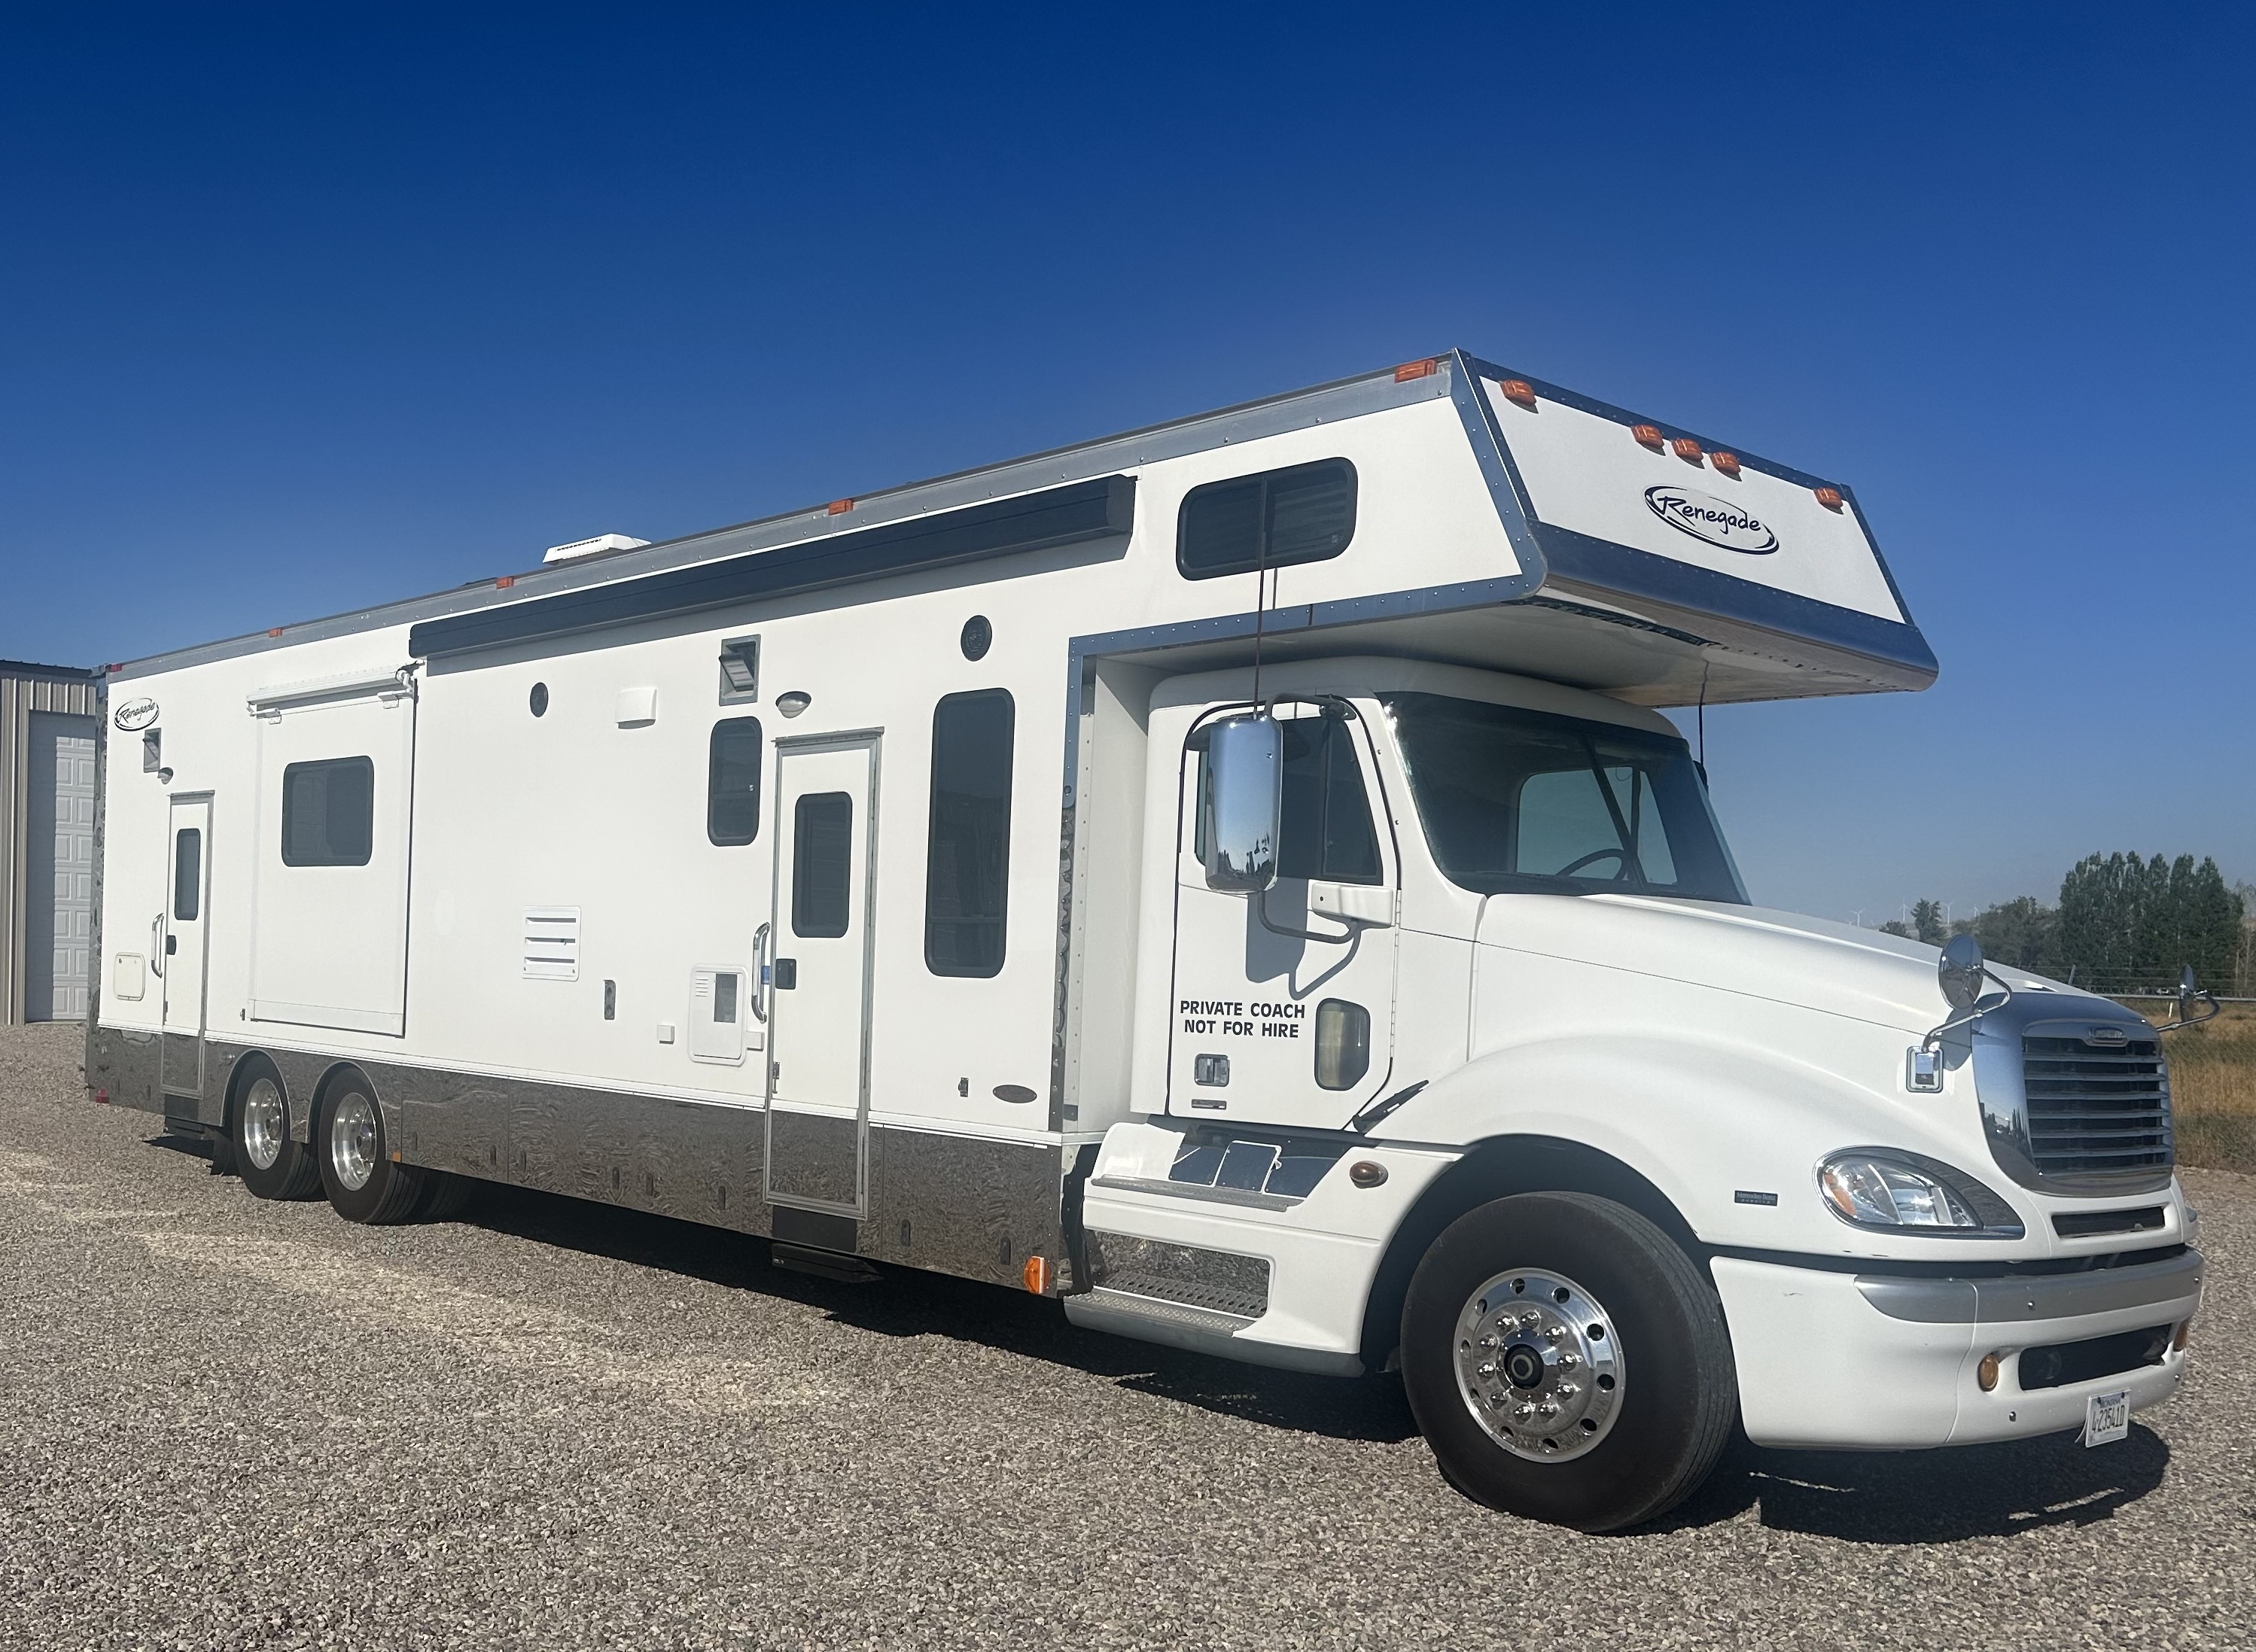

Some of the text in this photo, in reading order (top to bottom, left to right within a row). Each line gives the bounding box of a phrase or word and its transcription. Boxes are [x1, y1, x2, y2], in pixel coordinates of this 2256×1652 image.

[1657, 495, 1761, 535] Renegade
[119, 701, 155, 723] Renegade
[1180, 1000, 1305, 1018] PRIVATE COACH
[1184, 1019, 1299, 1038] NOT FOR HIRE
